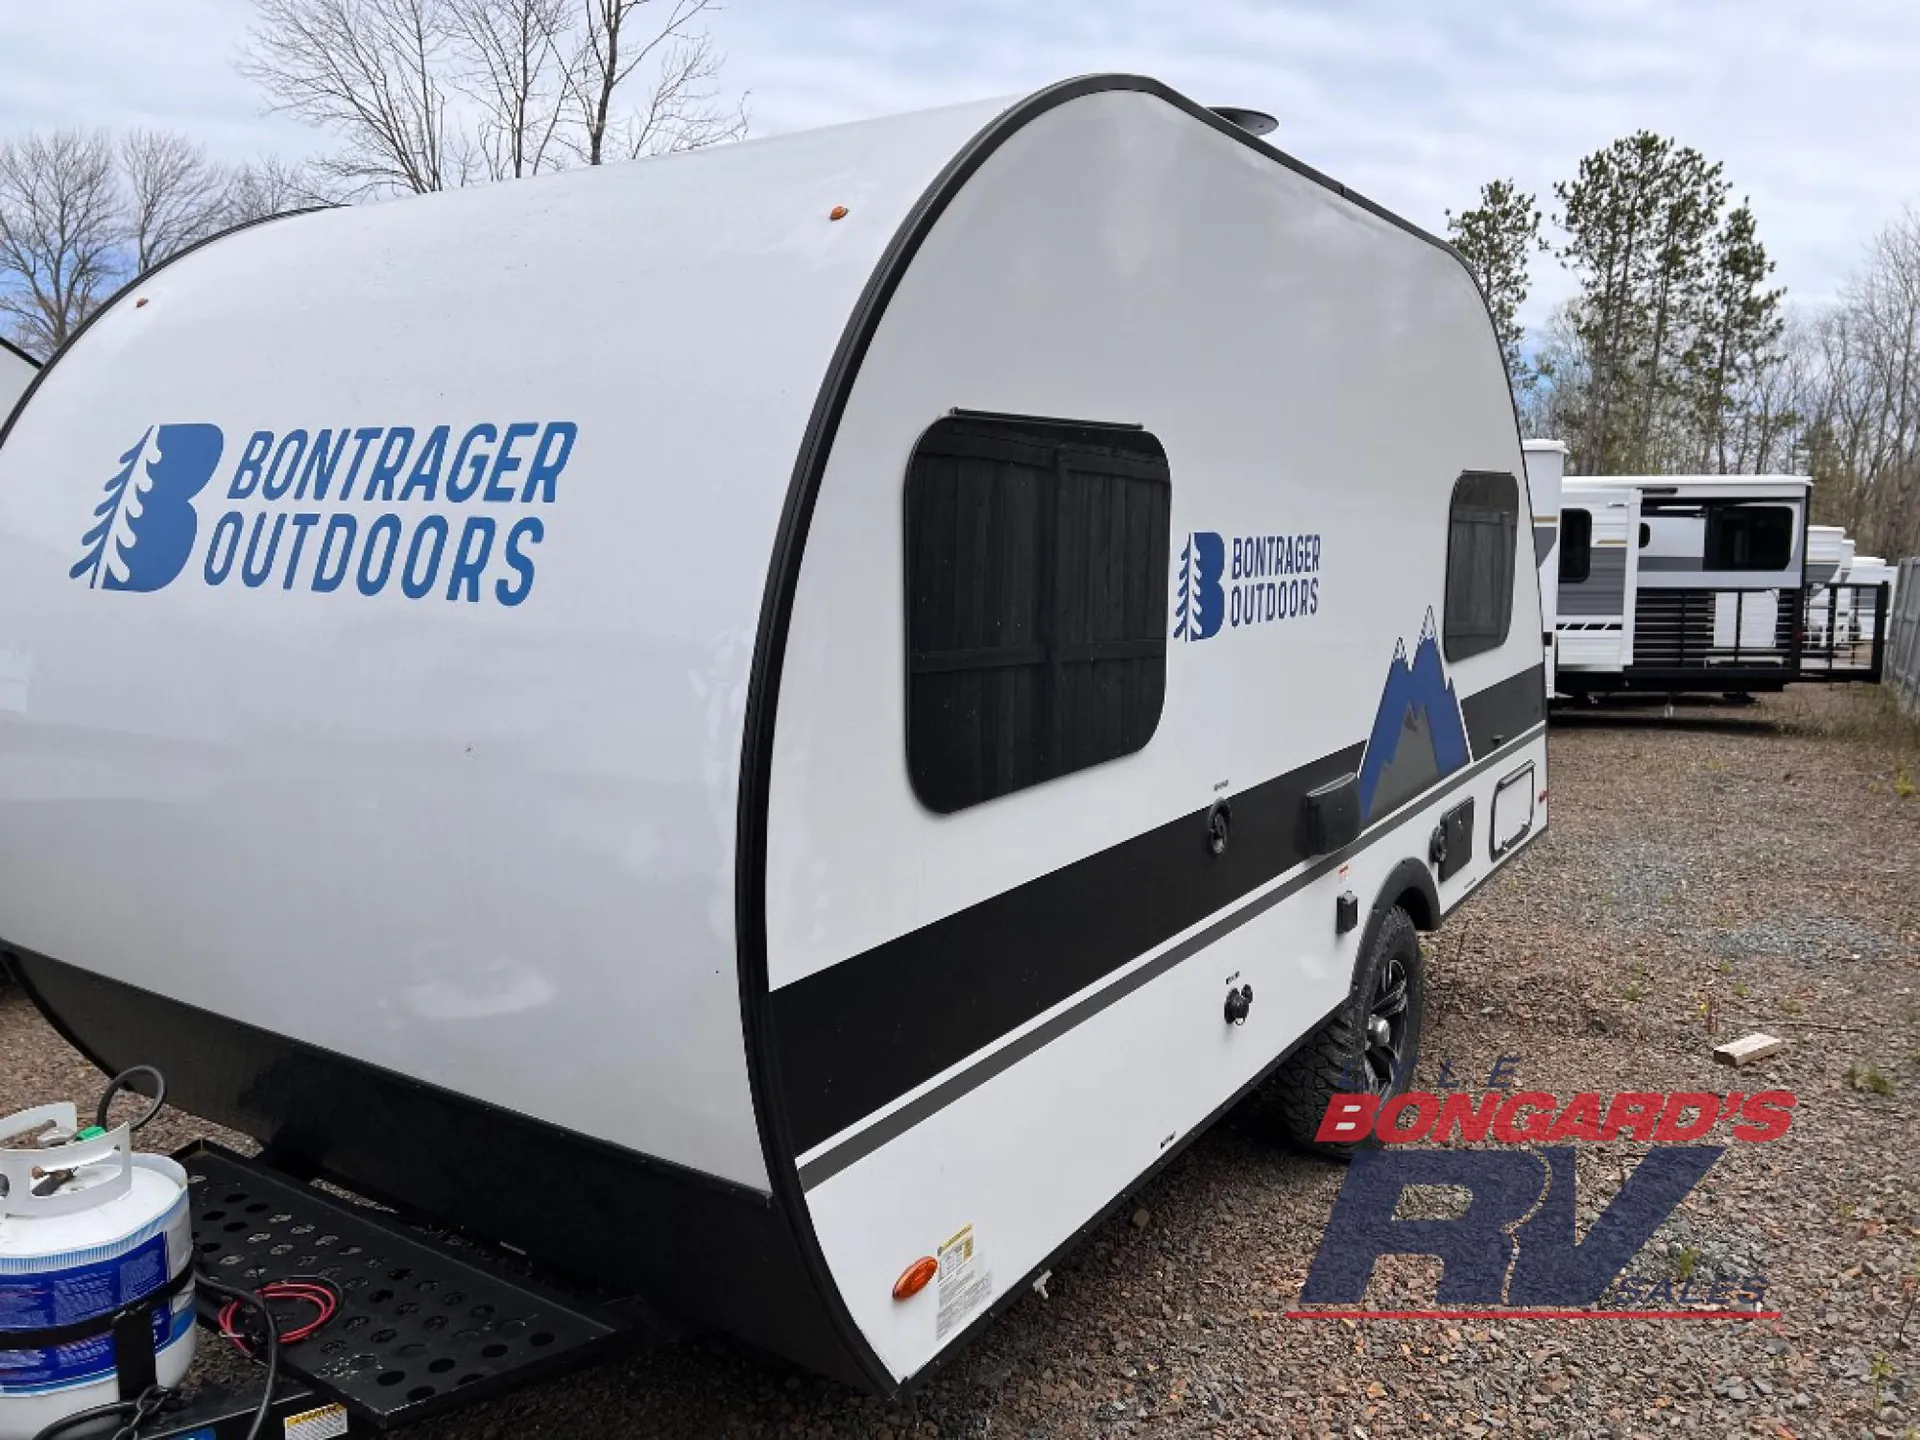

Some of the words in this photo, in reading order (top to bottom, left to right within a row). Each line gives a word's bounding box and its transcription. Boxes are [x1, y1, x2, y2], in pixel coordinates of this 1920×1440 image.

[227, 421, 578, 504] BONTRAGER
[203, 510, 544, 607] OUTDOORS
[1231, 534, 1321, 580] BONTRAGER
[1231, 577, 1319, 628] OUTDOORS
